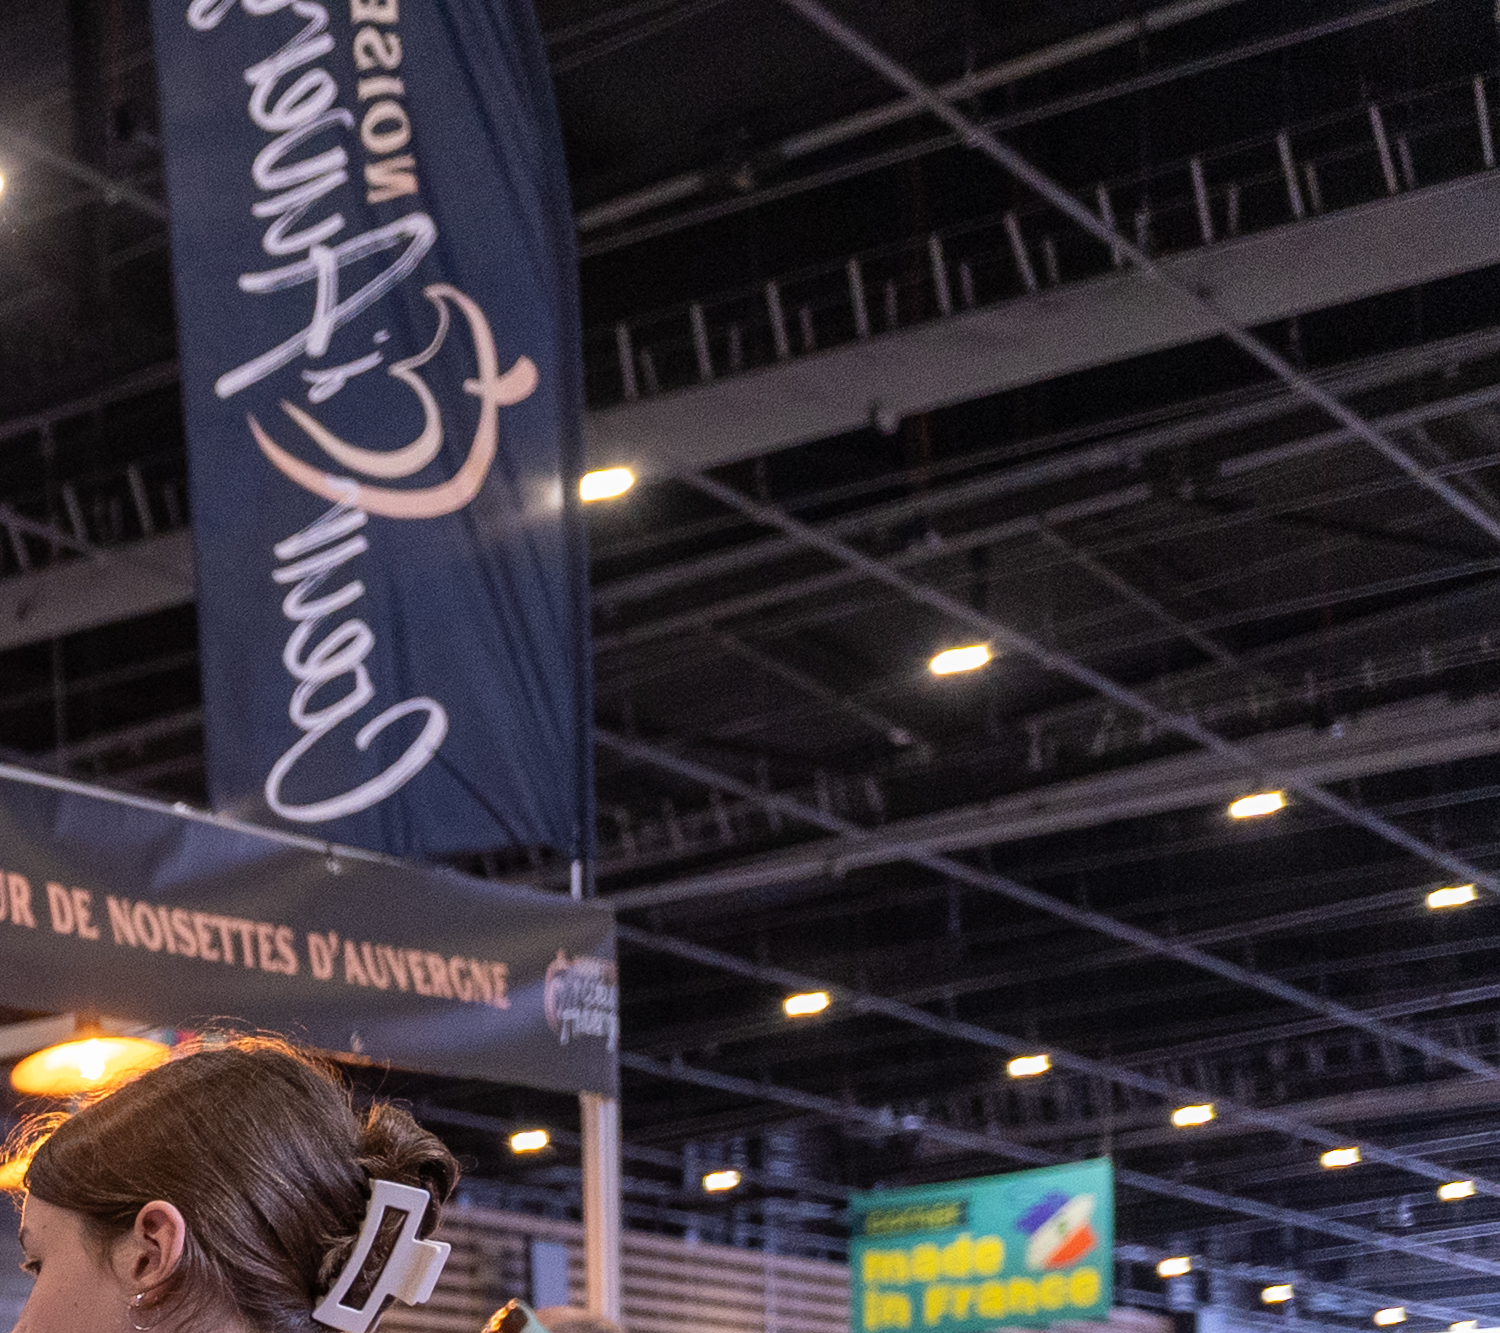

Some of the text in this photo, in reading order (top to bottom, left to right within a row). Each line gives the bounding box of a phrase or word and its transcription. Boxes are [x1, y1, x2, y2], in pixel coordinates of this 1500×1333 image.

[49, 881, 97, 940] DE
[109, 896, 297, 979] NOISETTES
[309, 929, 510, 1010] D'AUVERGNE
[862, 1233, 1005, 1284] made
[863, 1286, 911, 1332] in
